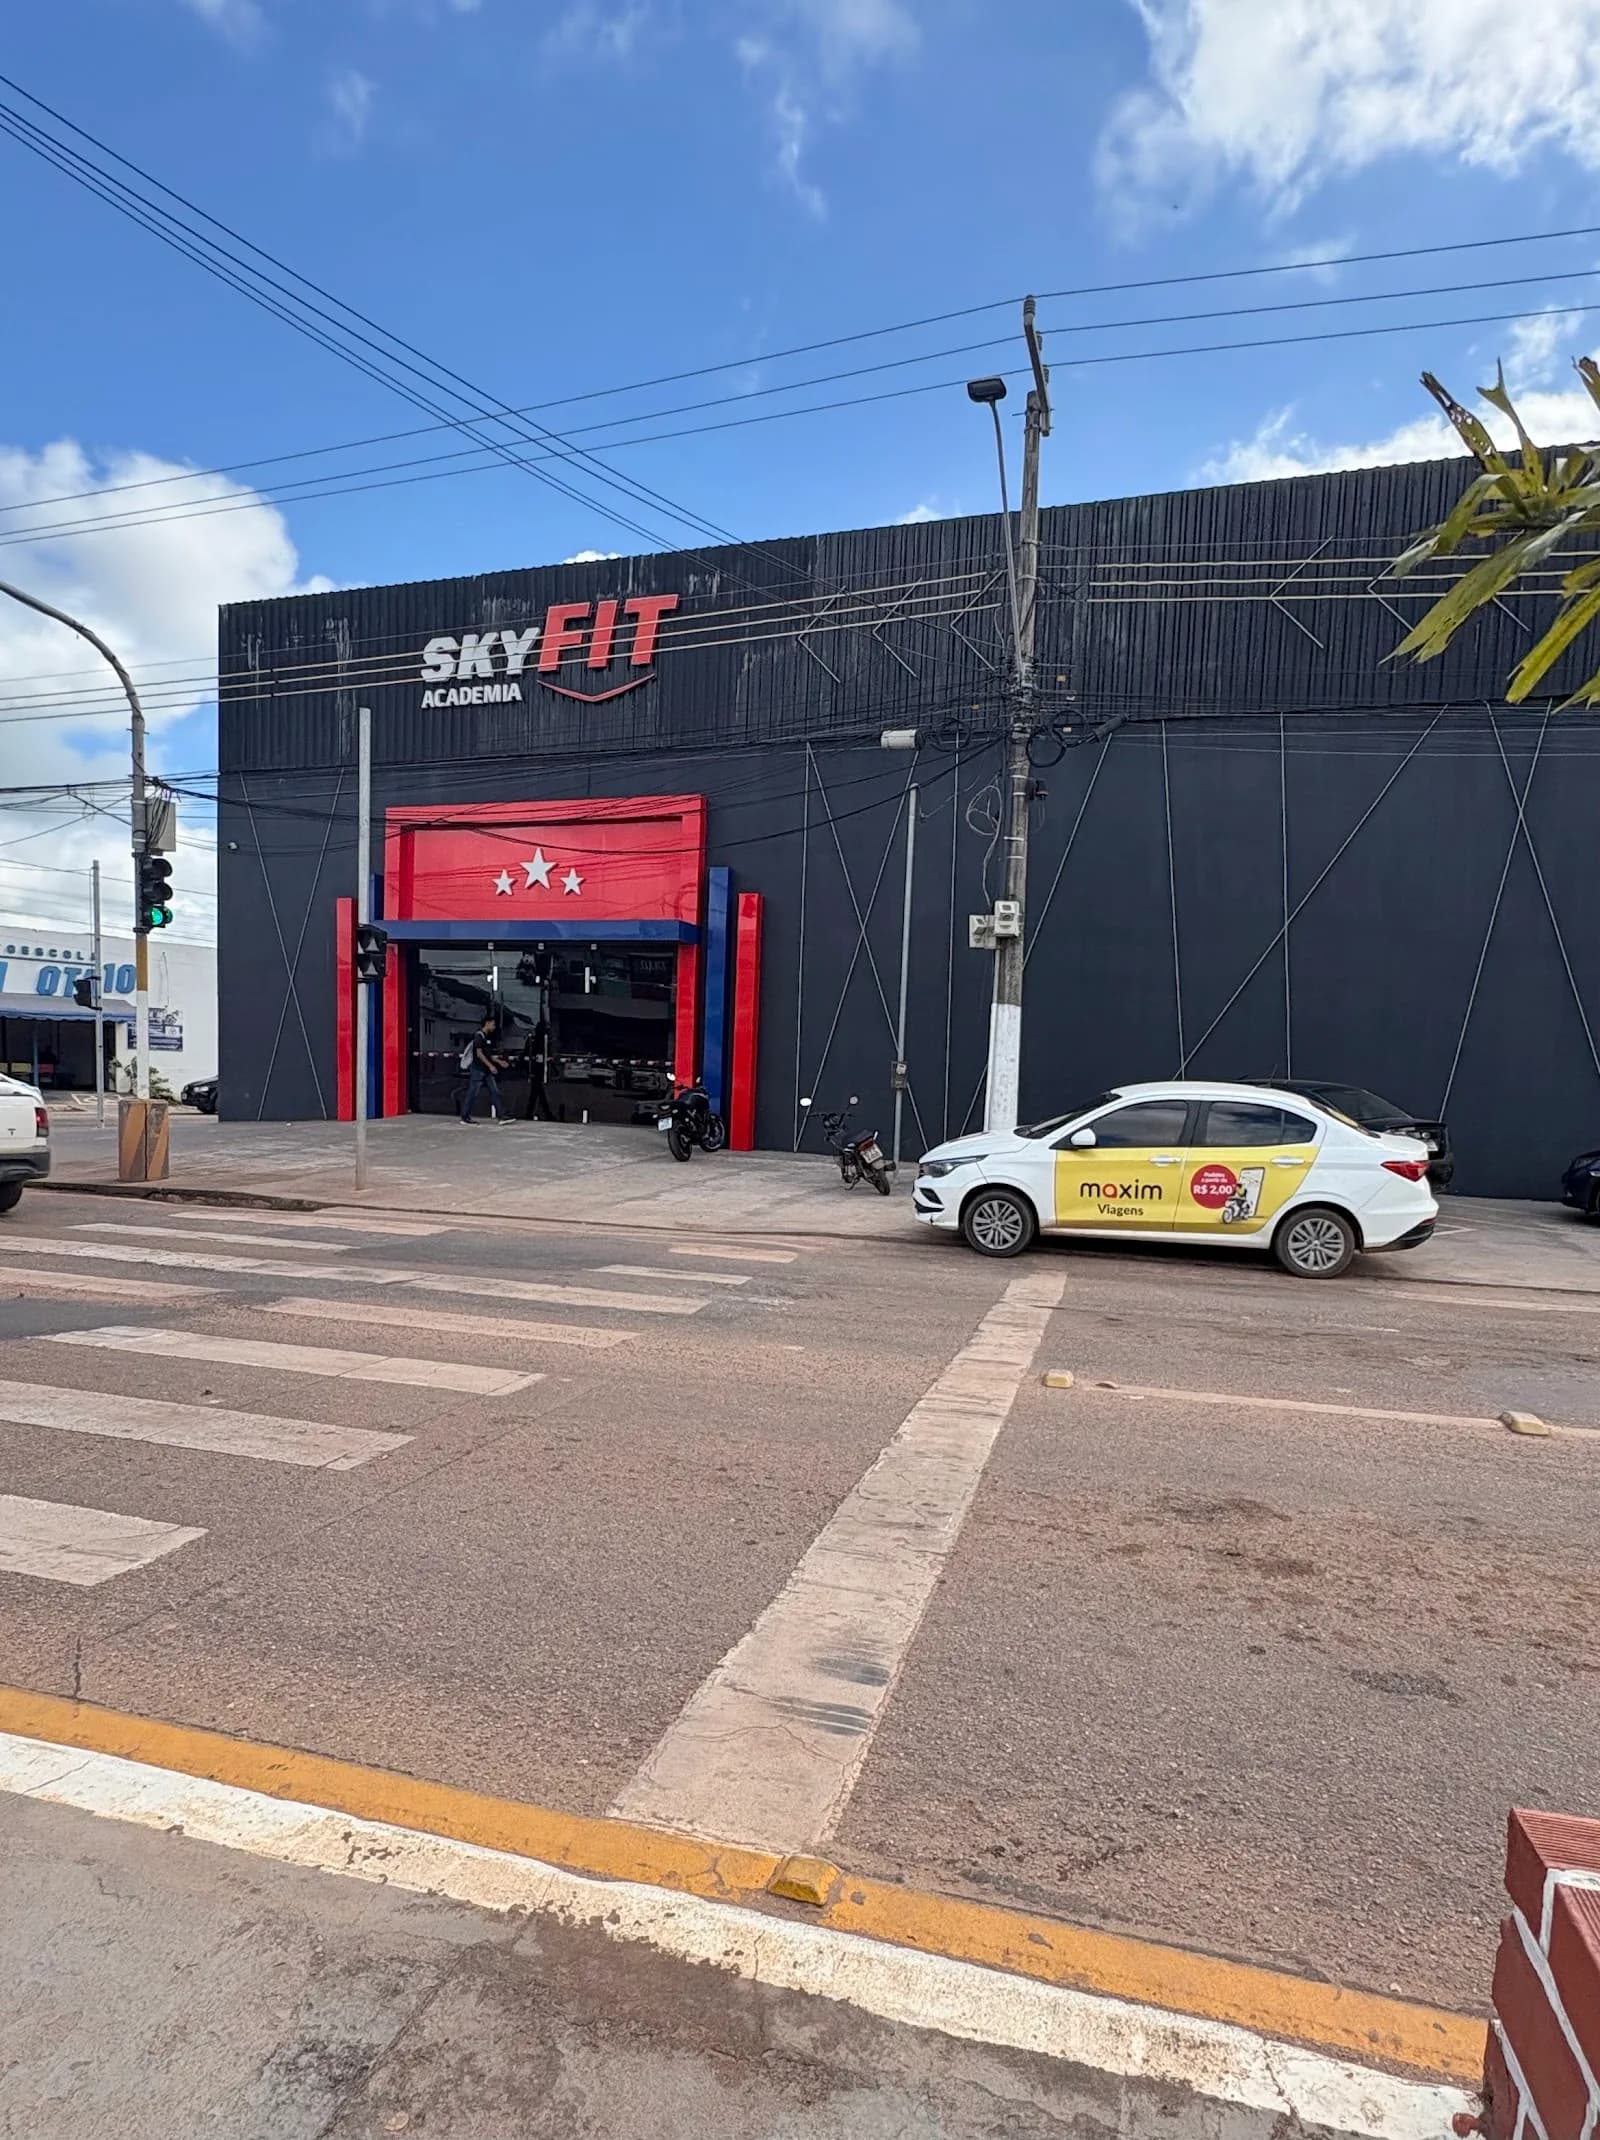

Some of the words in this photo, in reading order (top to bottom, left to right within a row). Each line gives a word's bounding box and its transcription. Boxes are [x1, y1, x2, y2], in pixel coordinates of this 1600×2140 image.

[420, 682, 523, 709] ACADEMIA
[1080, 1179, 1163, 1201] maxim
[1097, 1203, 1144, 1217] Viagens
